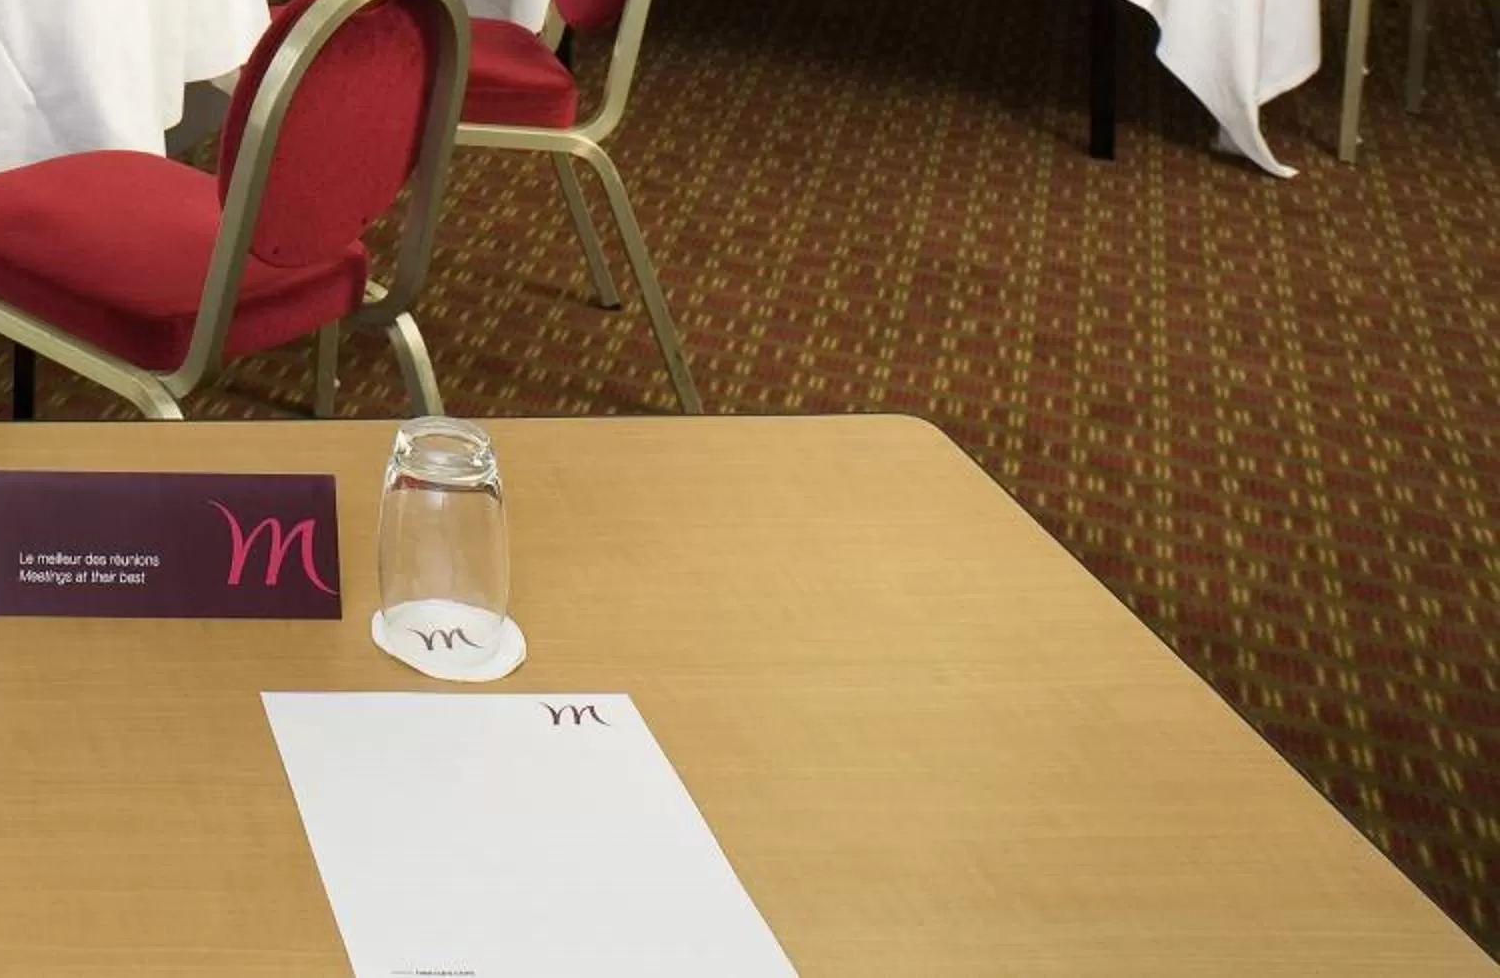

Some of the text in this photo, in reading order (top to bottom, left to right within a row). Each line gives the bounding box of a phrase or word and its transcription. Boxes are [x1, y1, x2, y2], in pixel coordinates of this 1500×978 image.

[19, 551, 34, 565] Le
[37, 551, 82, 566] meilleur
[84, 551, 107, 566] des
[19, 569, 146, 586] Meetings at their best
